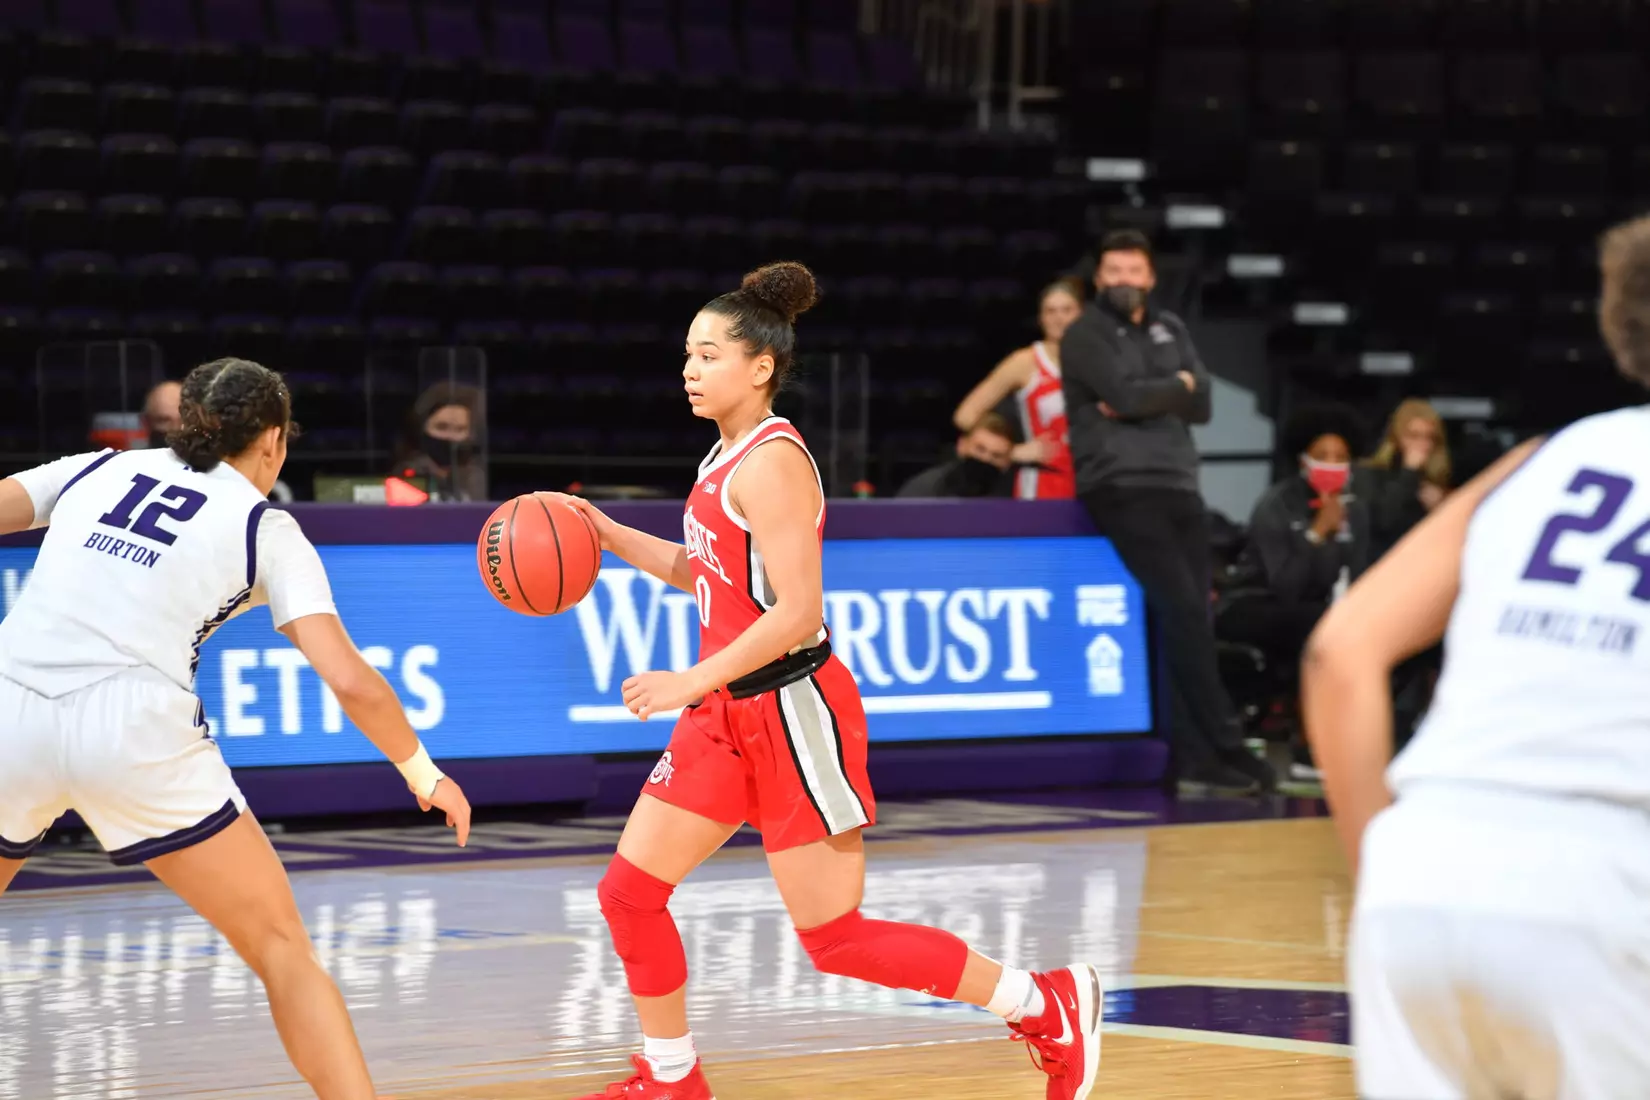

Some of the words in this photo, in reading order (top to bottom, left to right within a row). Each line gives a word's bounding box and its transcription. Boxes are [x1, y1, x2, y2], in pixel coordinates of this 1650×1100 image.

[98, 473, 208, 546] 12
[83, 532, 162, 568] BURTON
[486, 520, 511, 600] Wilson
[574, 568, 1052, 692] WIRUST
